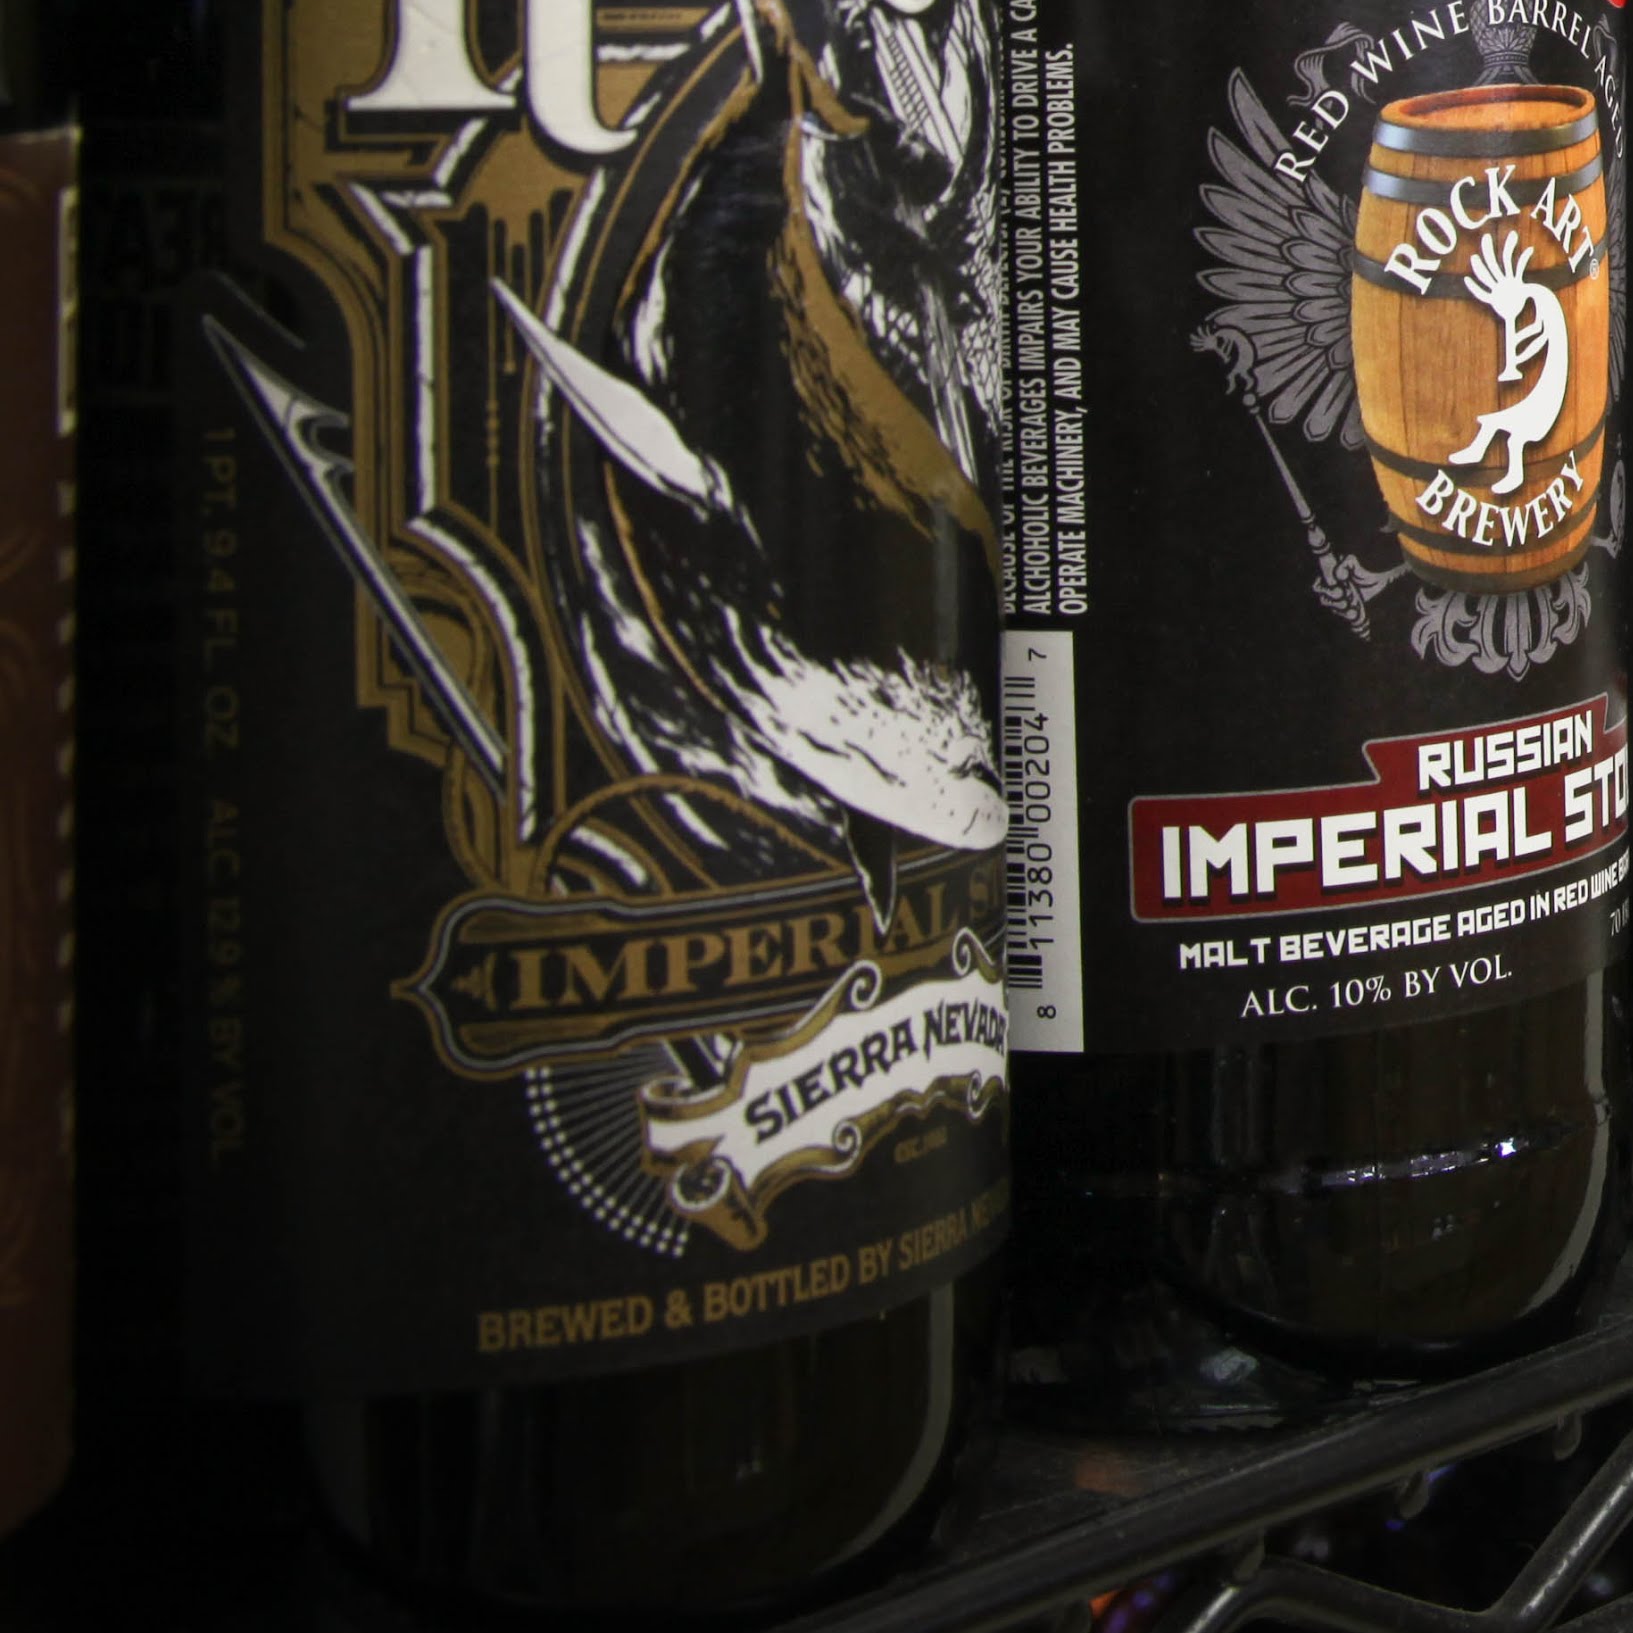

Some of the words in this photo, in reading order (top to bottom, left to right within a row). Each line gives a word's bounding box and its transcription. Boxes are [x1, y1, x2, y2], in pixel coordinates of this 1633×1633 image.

[1009, 26, 1039, 42] A
[1010, 47, 1040, 107] DRIVE
[1010, 113, 1041, 140] TO
[1045, 41, 1077, 153] PROBLEMS.
[1275, 88, 1351, 183] RED
[1011, 145, 1042, 219] ABILITY
[1047, 159, 1079, 231] HEALTH
[1012, 225, 1044, 282] YOUR
[1049, 236, 1081, 299] CAUSE
[1383, 163, 1523, 296] ROCK
[1016, 288, 1047, 370] IMPAIRS
[1050, 304, 1082, 350] MAY
[1051, 355, 1083, 399] AND
[1018, 376, 1050, 486] BEVERAGES
[1053, 405, 1089, 524] MACHINERY,
[1414, 449, 1586, 549] BREWERY
[1021, 492, 1052, 615] ALCHOHOLIC
[1056, 528, 1089, 615] OPERATE
[1027, 647, 1048, 662] 7
[1023, 712, 1052, 824] 00204
[1417, 710, 1594, 794] RUSSIAN
[1160, 787, 1554, 901] IMPERIAL
[1027, 842, 1056, 950] 11380
[1179, 936, 1272, 971] MALT
[1278, 916, 1452, 962] BEVERAGE
[1457, 898, 1527, 938] AGED
[1530, 889, 1550, 921] IN
[1553, 878, 1589, 914] RED
[1590, 861, 1618, 900] WINE
[510, 880, 961, 1011] IMPERIAL
[1240, 986, 1318, 1019] ALC.
[1330, 974, 1392, 1009] 10%
[1404, 963, 1444, 998] BY
[1448, 954, 1513, 986] VOL.
[1037, 1004, 1057, 1020] 8
[743, 1017, 919, 1144] SIERRA
[476, 1293, 654, 1354] BREWED
[664, 1289, 694, 1327] &
[703, 1253, 851, 1323] BOTTLED
[857, 1237, 896, 1286] BY
[898, 1207, 969, 1270] SIERRA
